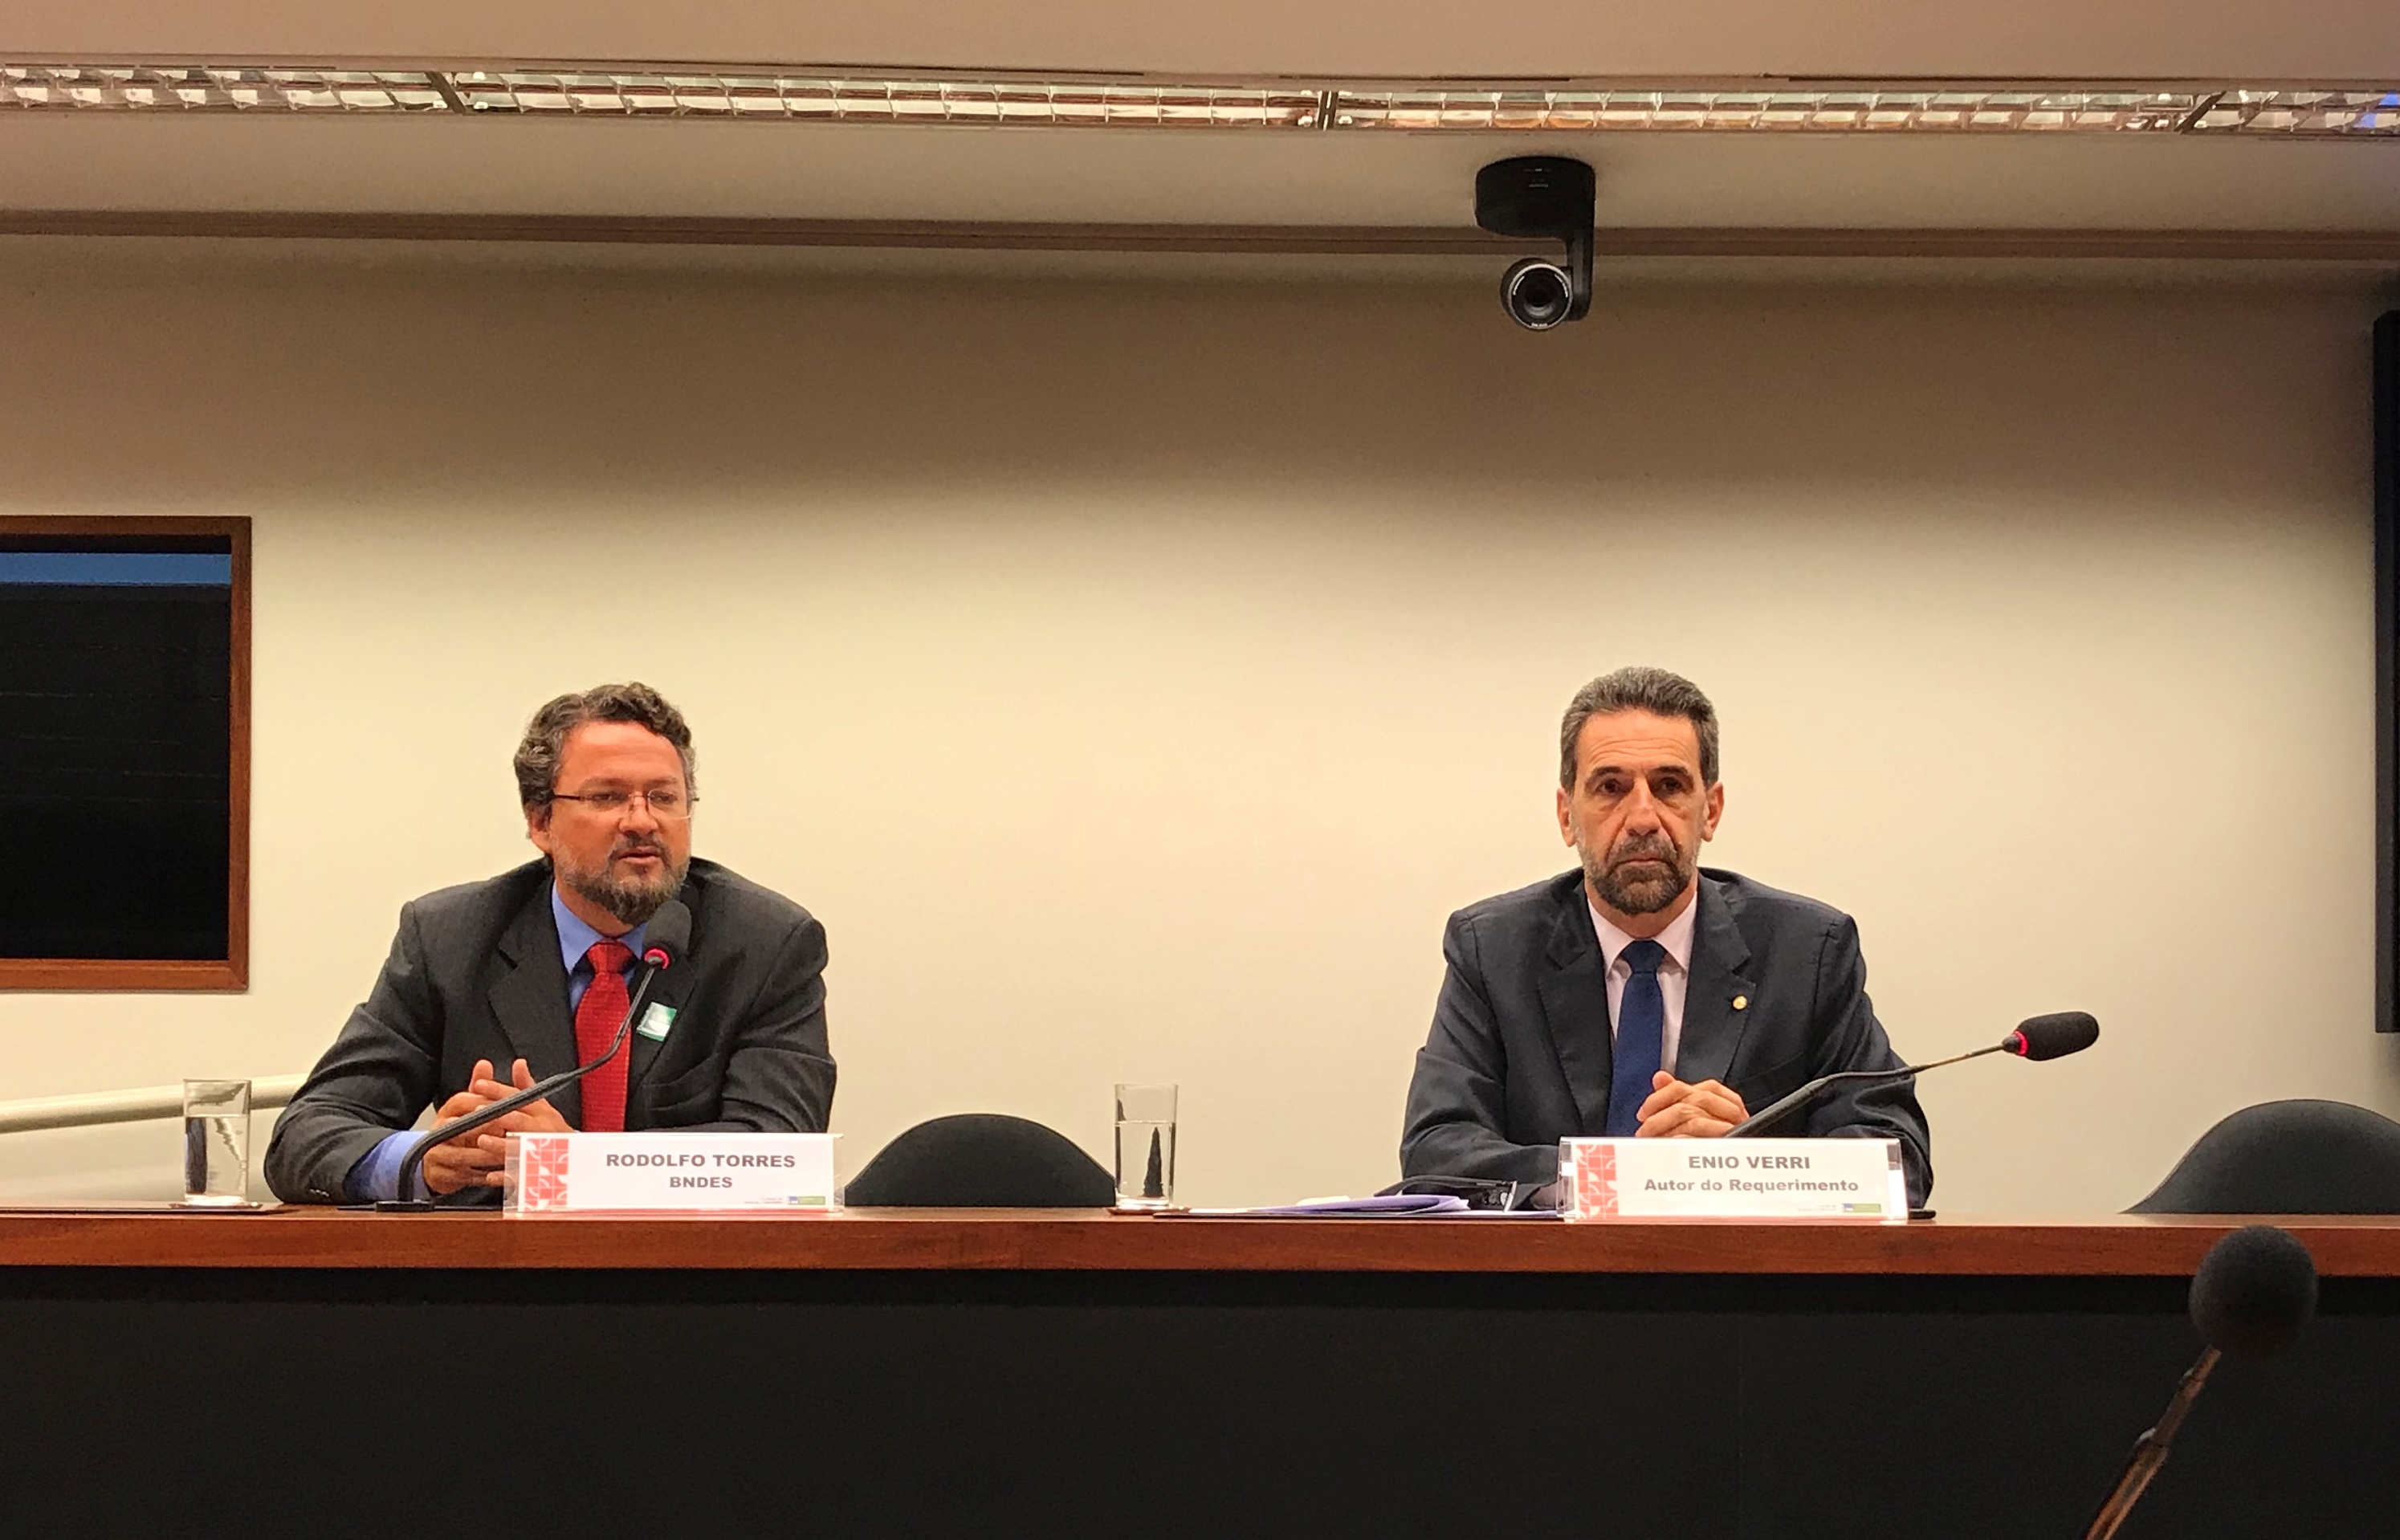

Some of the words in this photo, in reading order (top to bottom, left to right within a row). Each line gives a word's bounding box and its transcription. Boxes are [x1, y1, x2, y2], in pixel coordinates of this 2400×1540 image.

[606, 1154, 706, 1167] RODOLFO
[712, 1154, 796, 1168] TORRES
[1689, 1155, 1740, 1169] ENIO
[1746, 1155, 1811, 1170] VERRI
[670, 1176, 733, 1188] BNDES
[1644, 1179, 1695, 1191] Autor
[1701, 1179, 1723, 1191] do
[1729, 1179, 1859, 1194] Requerimento
